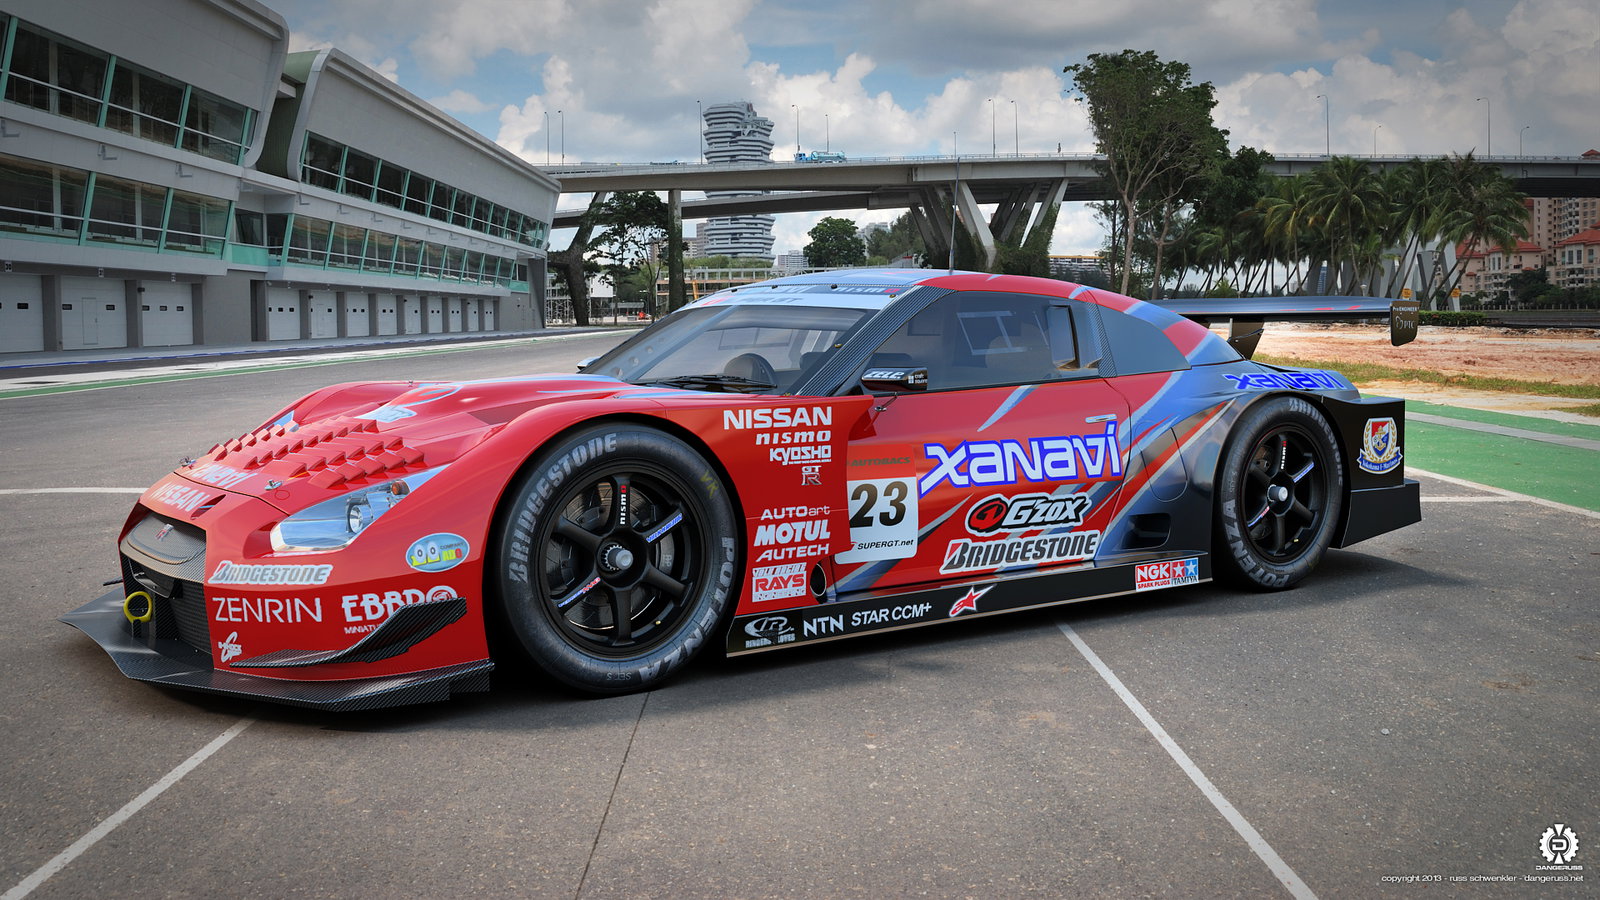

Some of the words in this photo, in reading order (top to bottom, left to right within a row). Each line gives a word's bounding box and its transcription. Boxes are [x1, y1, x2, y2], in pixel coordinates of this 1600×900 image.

[723, 406, 832, 430] NISSAN
[755, 430, 832, 446] nismo
[849, 457, 911, 467] AUTOBACS
[149, 481, 211, 512] NISSAN
[508, 432, 618, 584] BRIDGESTONE
[850, 481, 908, 528] 23
[753, 519, 831, 547] MOTUL
[857, 539, 914, 550] SUPERGT.net
[1222, 499, 1290, 588] POTENZA
[755, 543, 830, 562] AUTECH
[942, 533, 1099, 571] BRIDGESTONE
[209, 561, 332, 583] BRIDGESTONE
[755, 573, 805, 593] RAYS
[1137, 563, 1170, 582] NGK
[1173, 576, 1198, 585] TAMIYA
[212, 597, 322, 623] ZENRIN
[637, 536, 736, 681] POTENZA
[851, 607, 890, 627] STAR
[891, 602, 932, 621] CCM+
[803, 614, 844, 637] NTN
